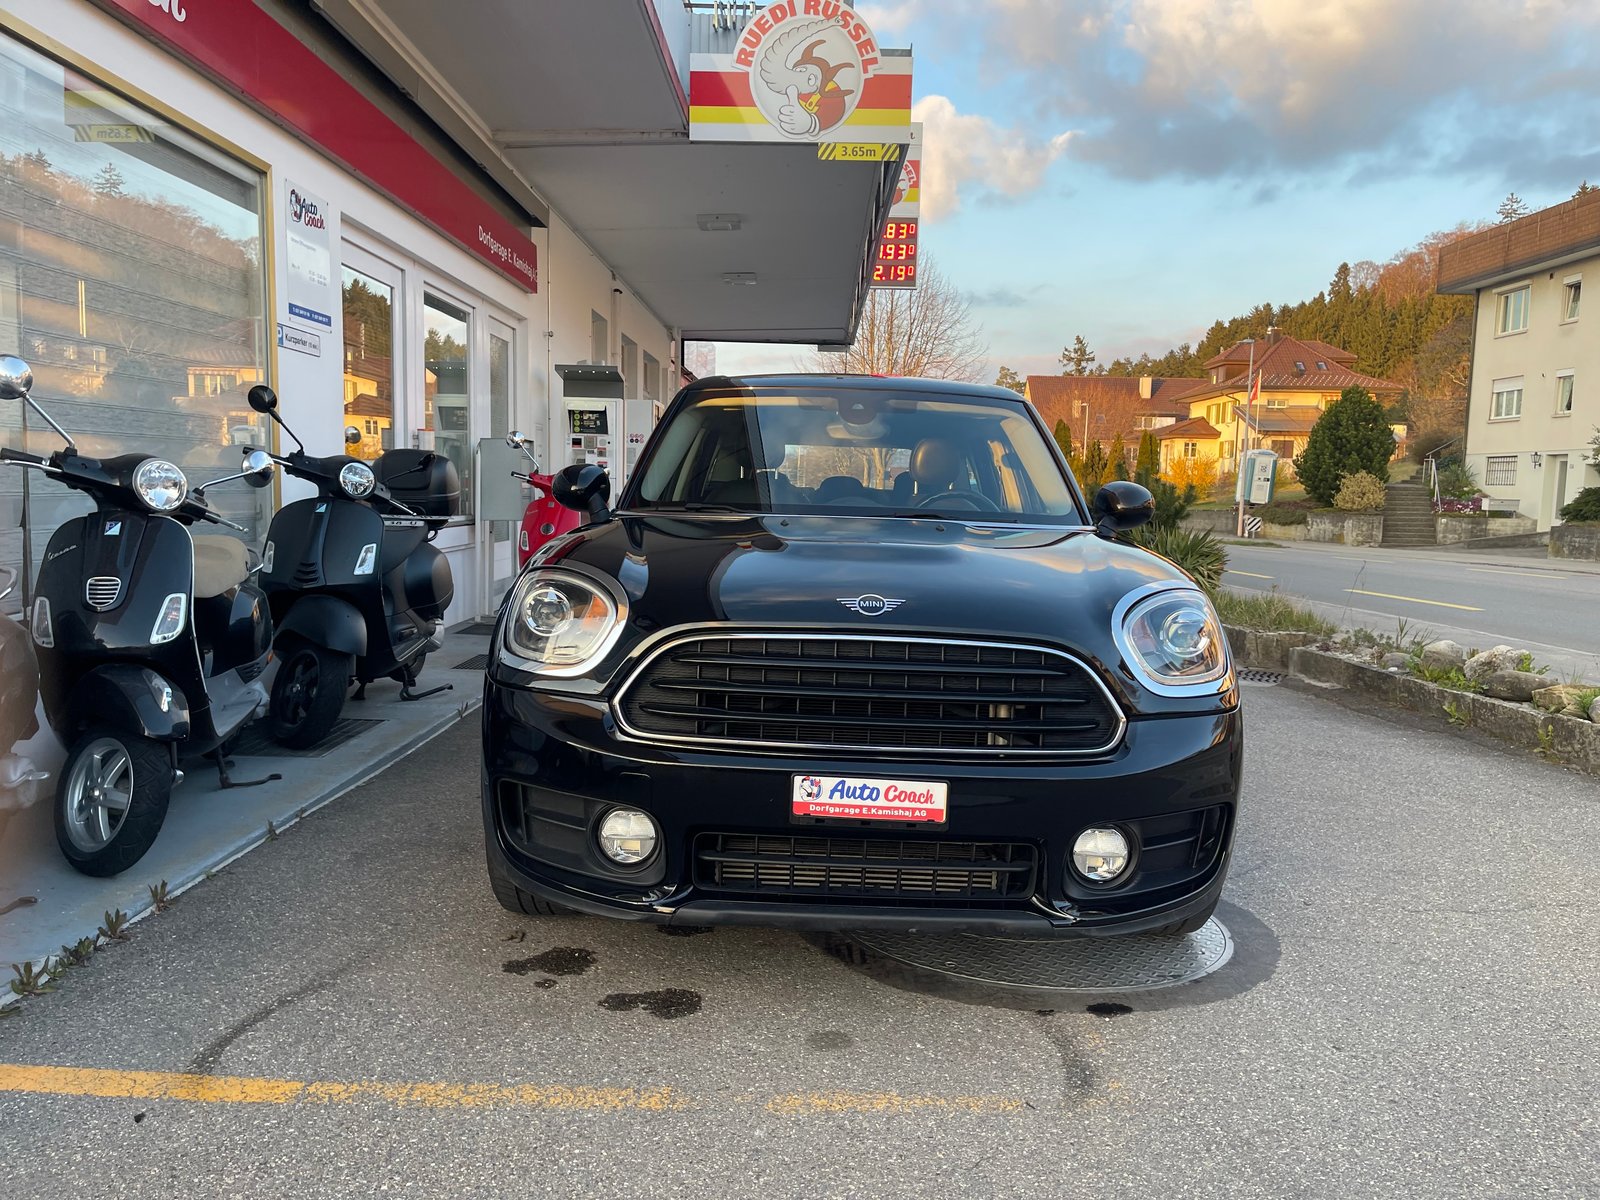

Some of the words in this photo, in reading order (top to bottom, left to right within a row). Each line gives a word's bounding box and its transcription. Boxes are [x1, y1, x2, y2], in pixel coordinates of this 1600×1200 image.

[736, 0, 797, 67] RUEDI
[804, 0, 879, 74] RÜSSEL
[841, 146, 876, 157] 3.65m
[301, 197, 318, 216] Auto
[304, 211, 325, 229] Coach
[883, 223, 916, 238] .830
[478, 224, 507, 261] Dorfgarage
[860, 600, 883, 608] MINI
[828, 779, 881, 802] Auto
[883, 784, 936, 805] Coach
[809, 804, 861, 815] Dorfgarage
